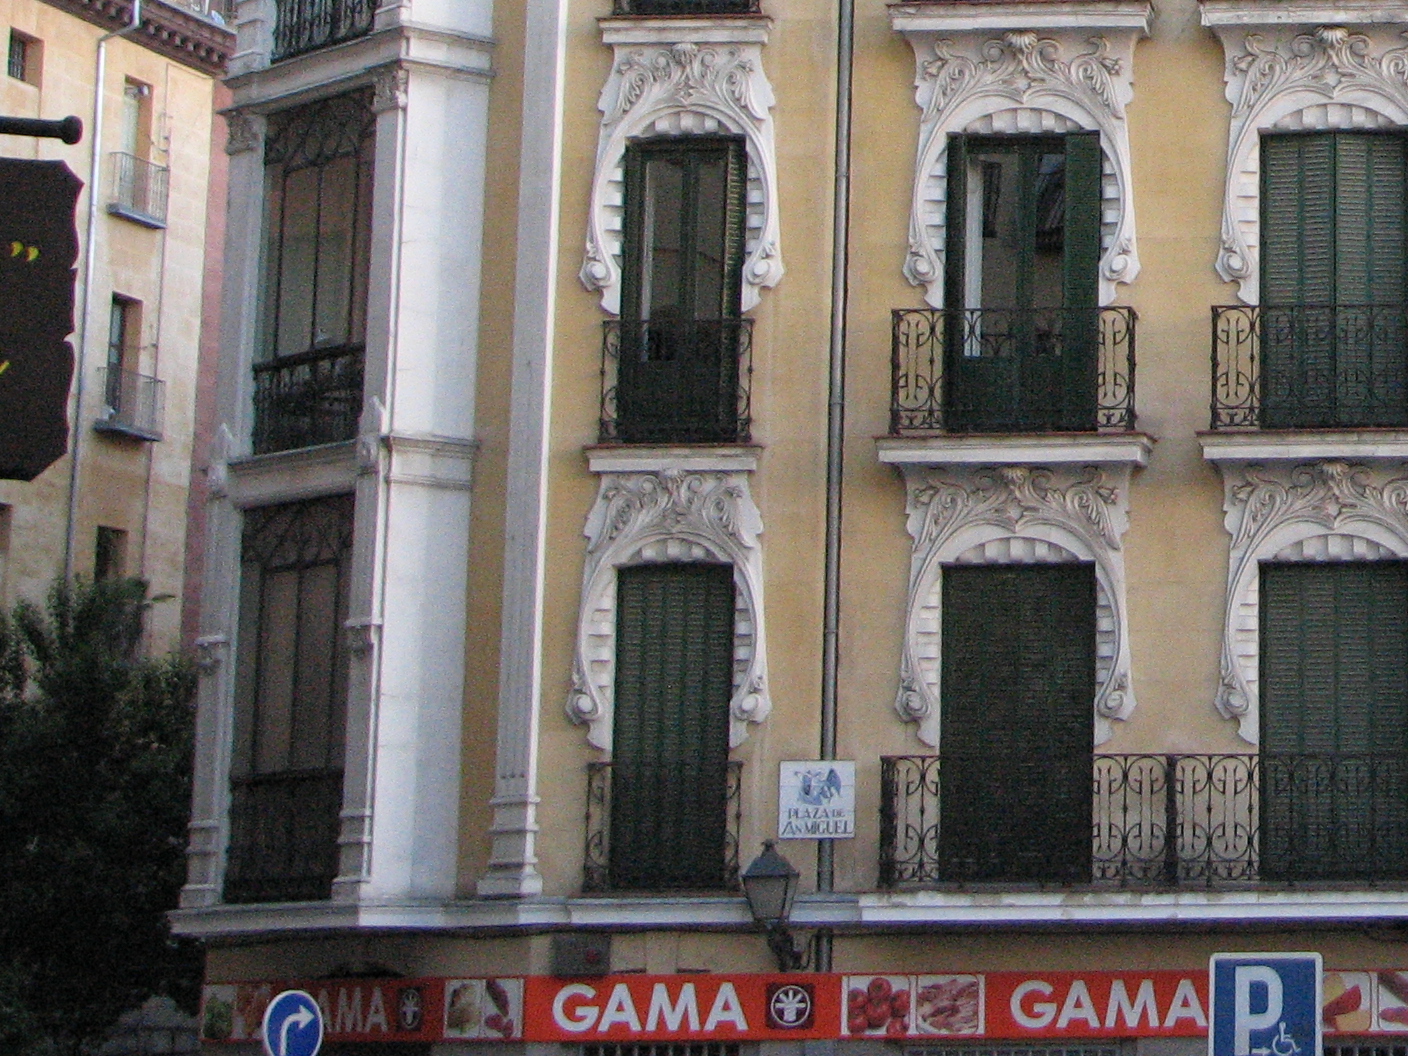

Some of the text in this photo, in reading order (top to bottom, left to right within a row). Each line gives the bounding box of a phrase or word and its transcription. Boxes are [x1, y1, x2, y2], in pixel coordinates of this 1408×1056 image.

[789, 807, 829, 819] PLAZA
[804, 820, 853, 834] MIGUEL
[317, 986, 388, 1033] AMA
[552, 982, 749, 1032] GAMA
[1010, 979, 1208, 1029] GAMA
[1234, 965, 1284, 1056] P
